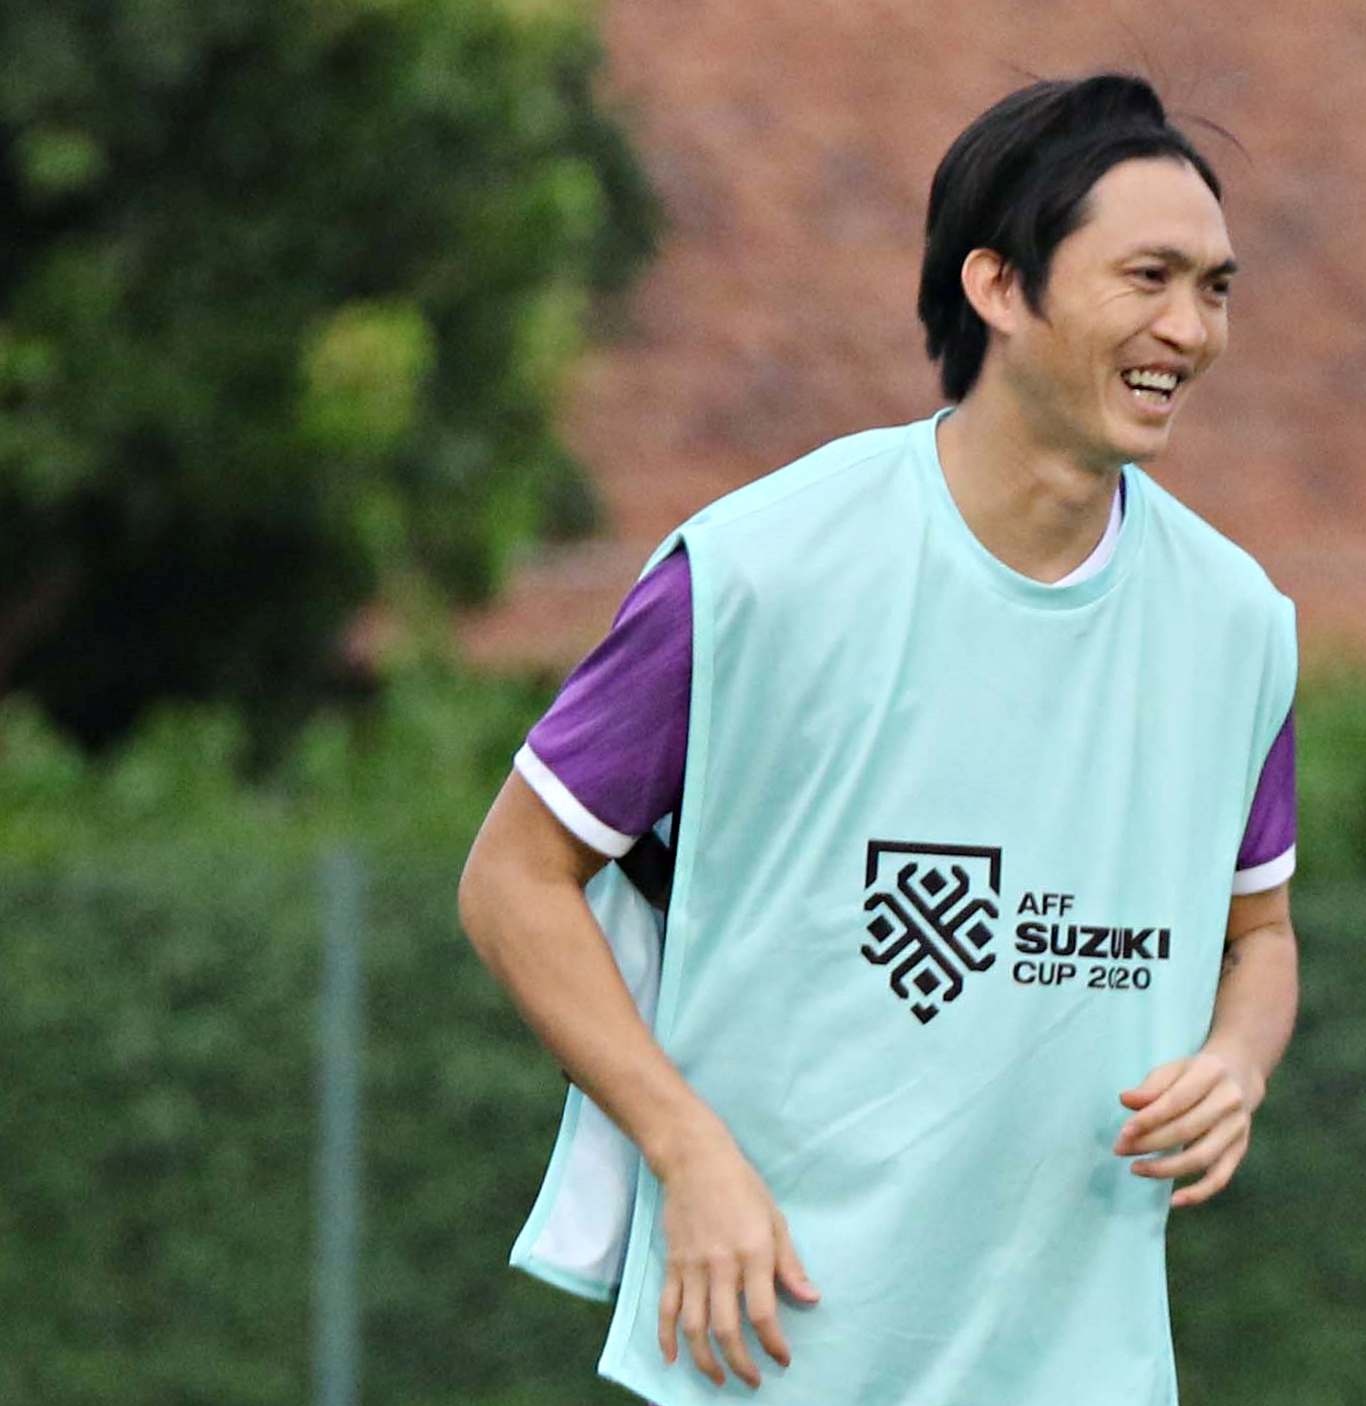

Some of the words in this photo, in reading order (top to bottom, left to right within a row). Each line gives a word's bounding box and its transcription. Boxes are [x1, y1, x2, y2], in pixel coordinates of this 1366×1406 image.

[1017, 892, 1075, 917] AFF
[1015, 922, 1170, 960] SUZUKI
[1012, 961, 1077, 986] CUP
